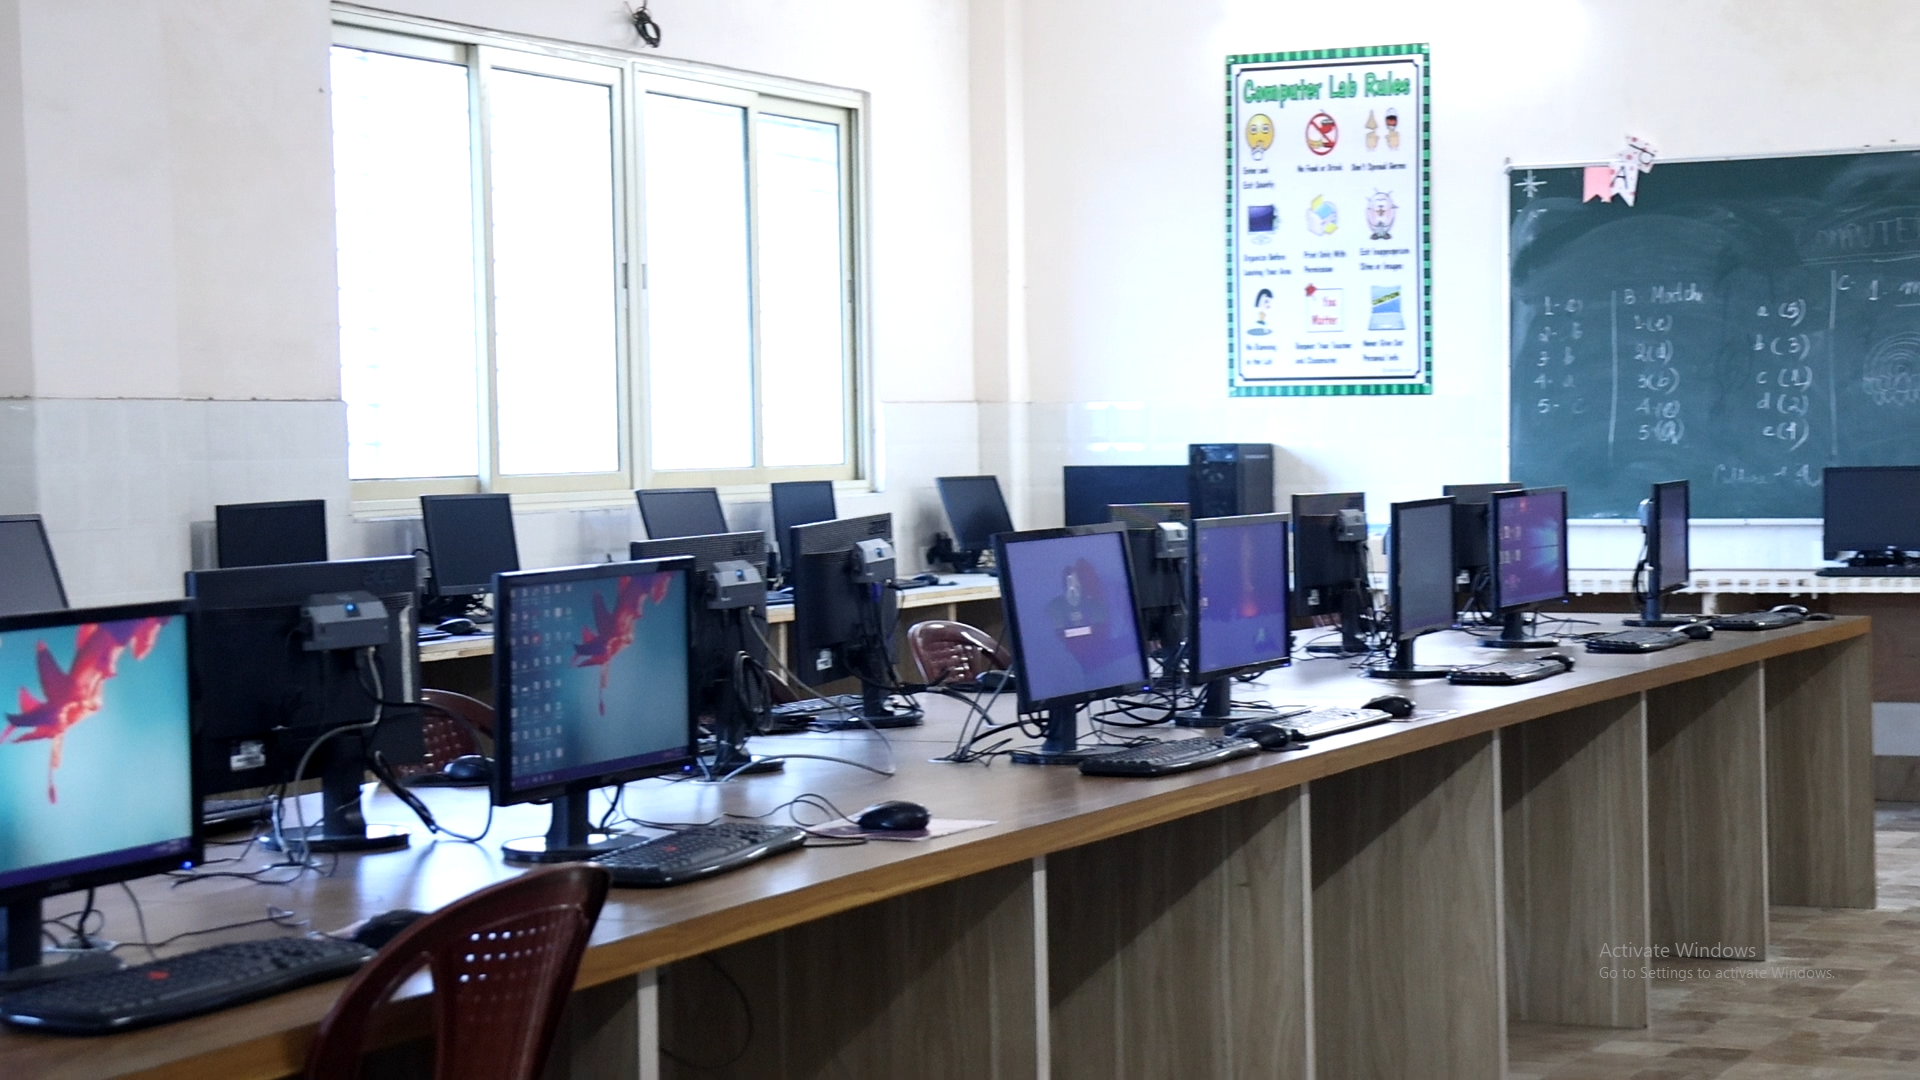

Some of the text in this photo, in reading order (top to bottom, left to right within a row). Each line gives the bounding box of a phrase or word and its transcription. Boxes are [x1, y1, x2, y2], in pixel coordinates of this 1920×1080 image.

[1243, 71, 1411, 109] Computer Lab Rules
[1306, 164, 1319, 173] Food
